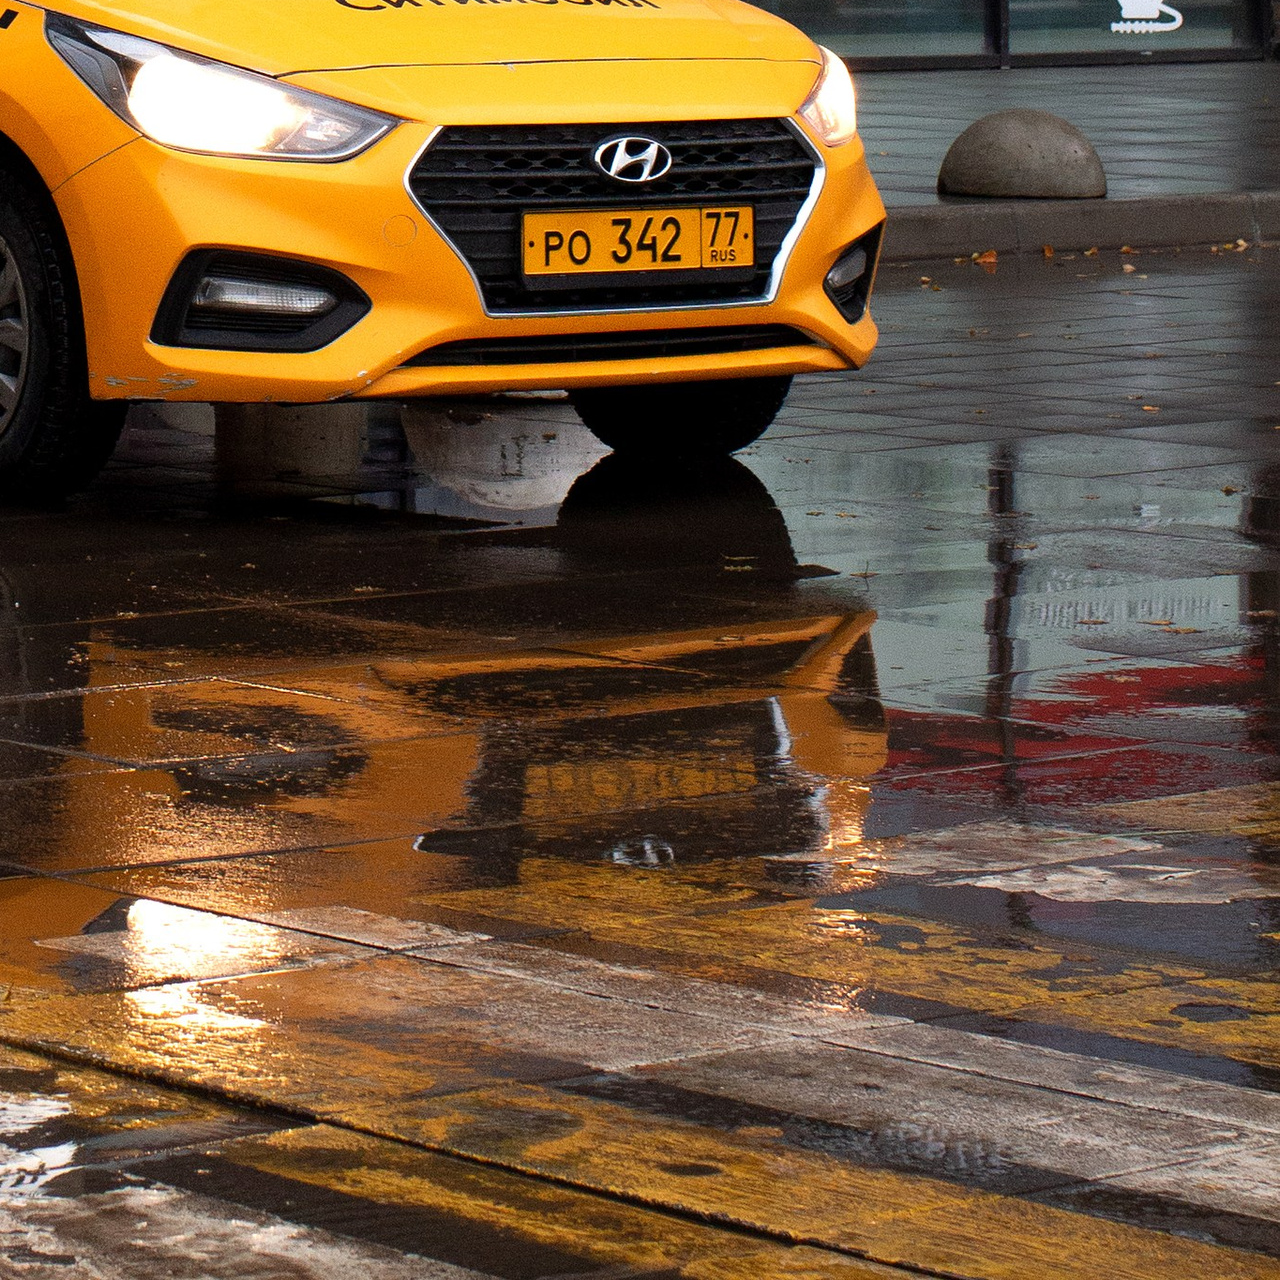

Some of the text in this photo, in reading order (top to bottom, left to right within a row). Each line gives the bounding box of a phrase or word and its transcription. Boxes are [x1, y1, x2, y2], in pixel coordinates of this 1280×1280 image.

[610, 217, 683, 264] 342
[704, 211, 740, 247] 77
[709, 249, 737, 263] RUS
